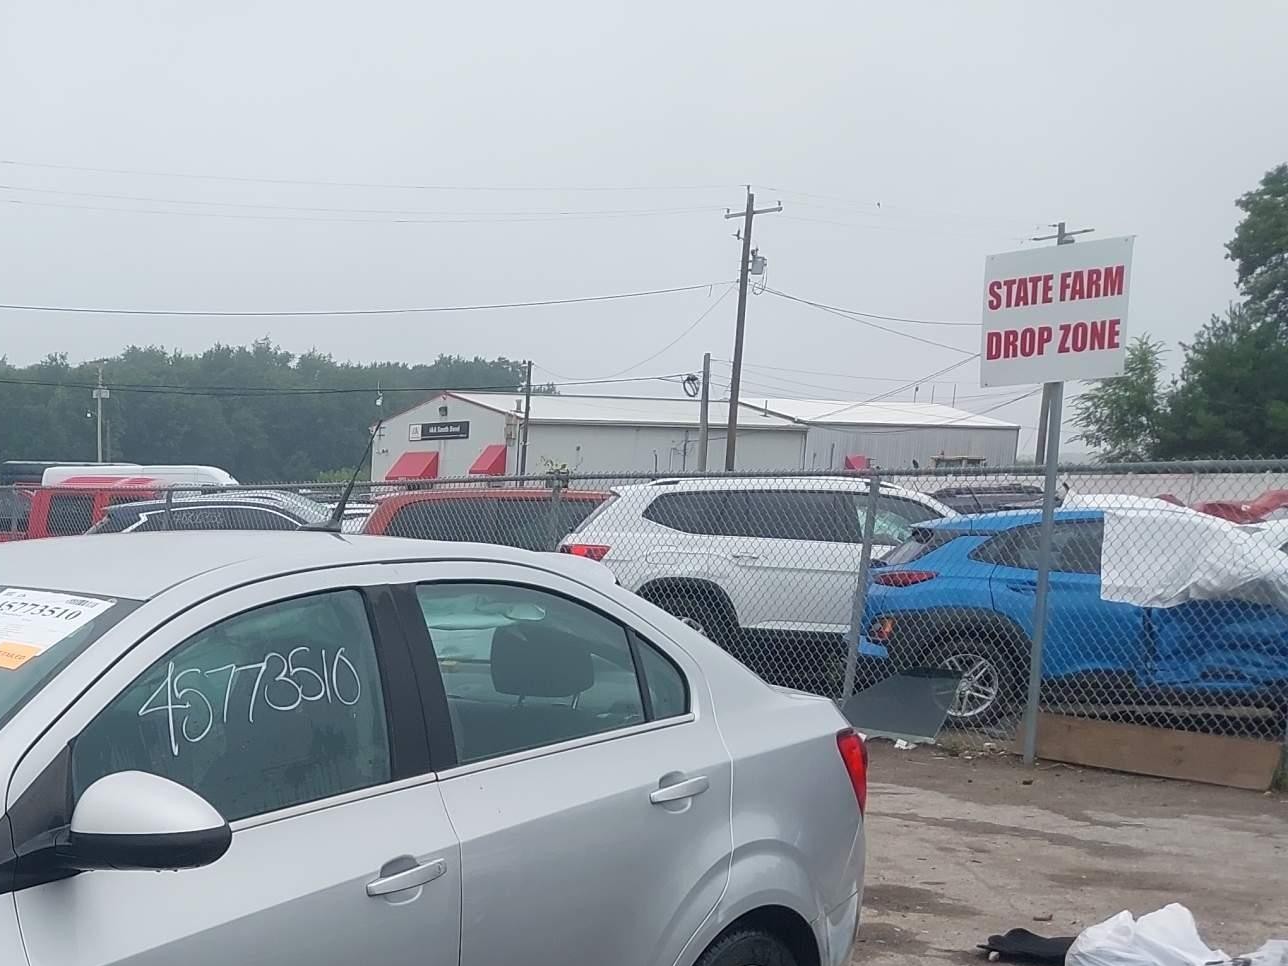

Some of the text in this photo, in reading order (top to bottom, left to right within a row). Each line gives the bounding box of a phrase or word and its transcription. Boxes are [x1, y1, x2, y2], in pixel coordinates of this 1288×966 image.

[988, 265, 1125, 310] STATE FARM
[986, 319, 1121, 360] DROP ZONE
[138, 647, 361, 756] 45773510
